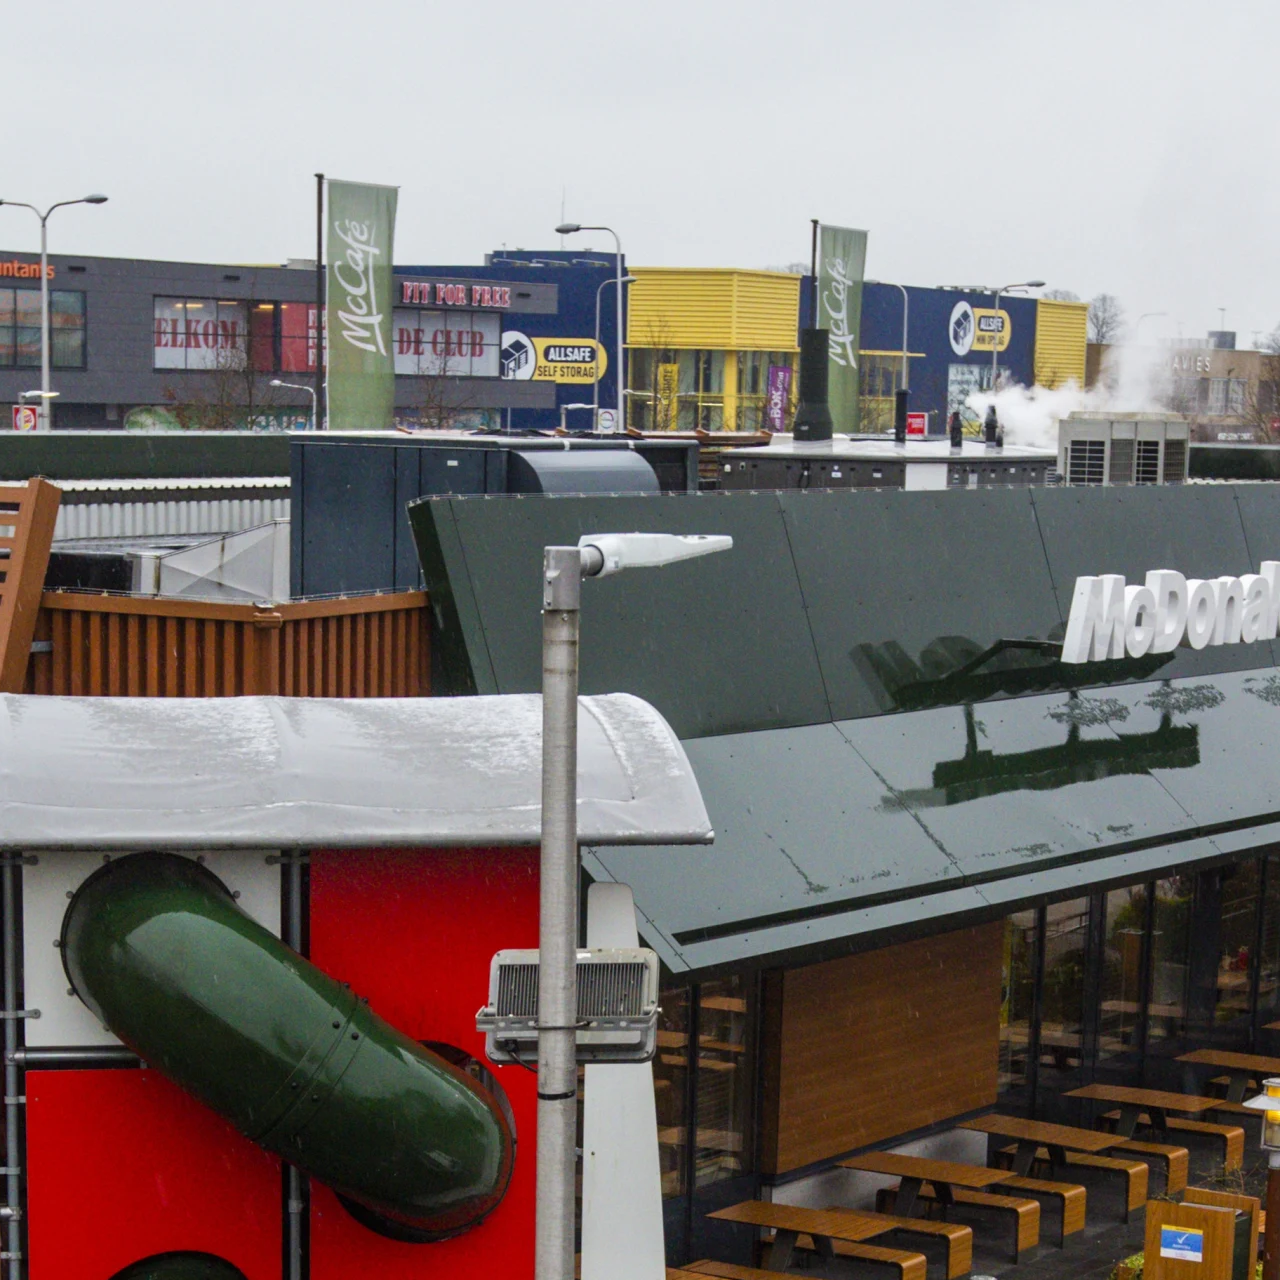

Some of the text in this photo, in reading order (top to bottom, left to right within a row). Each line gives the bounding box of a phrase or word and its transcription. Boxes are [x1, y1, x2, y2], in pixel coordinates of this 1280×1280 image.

[334, 218, 386, 356] McCafé
[402, 281, 511, 308] FIT FOR FREE
[398, 327, 485, 358] DE CLUB
[548, 346, 591, 362] ALLSAFE
[537, 365, 558, 377] SELF
